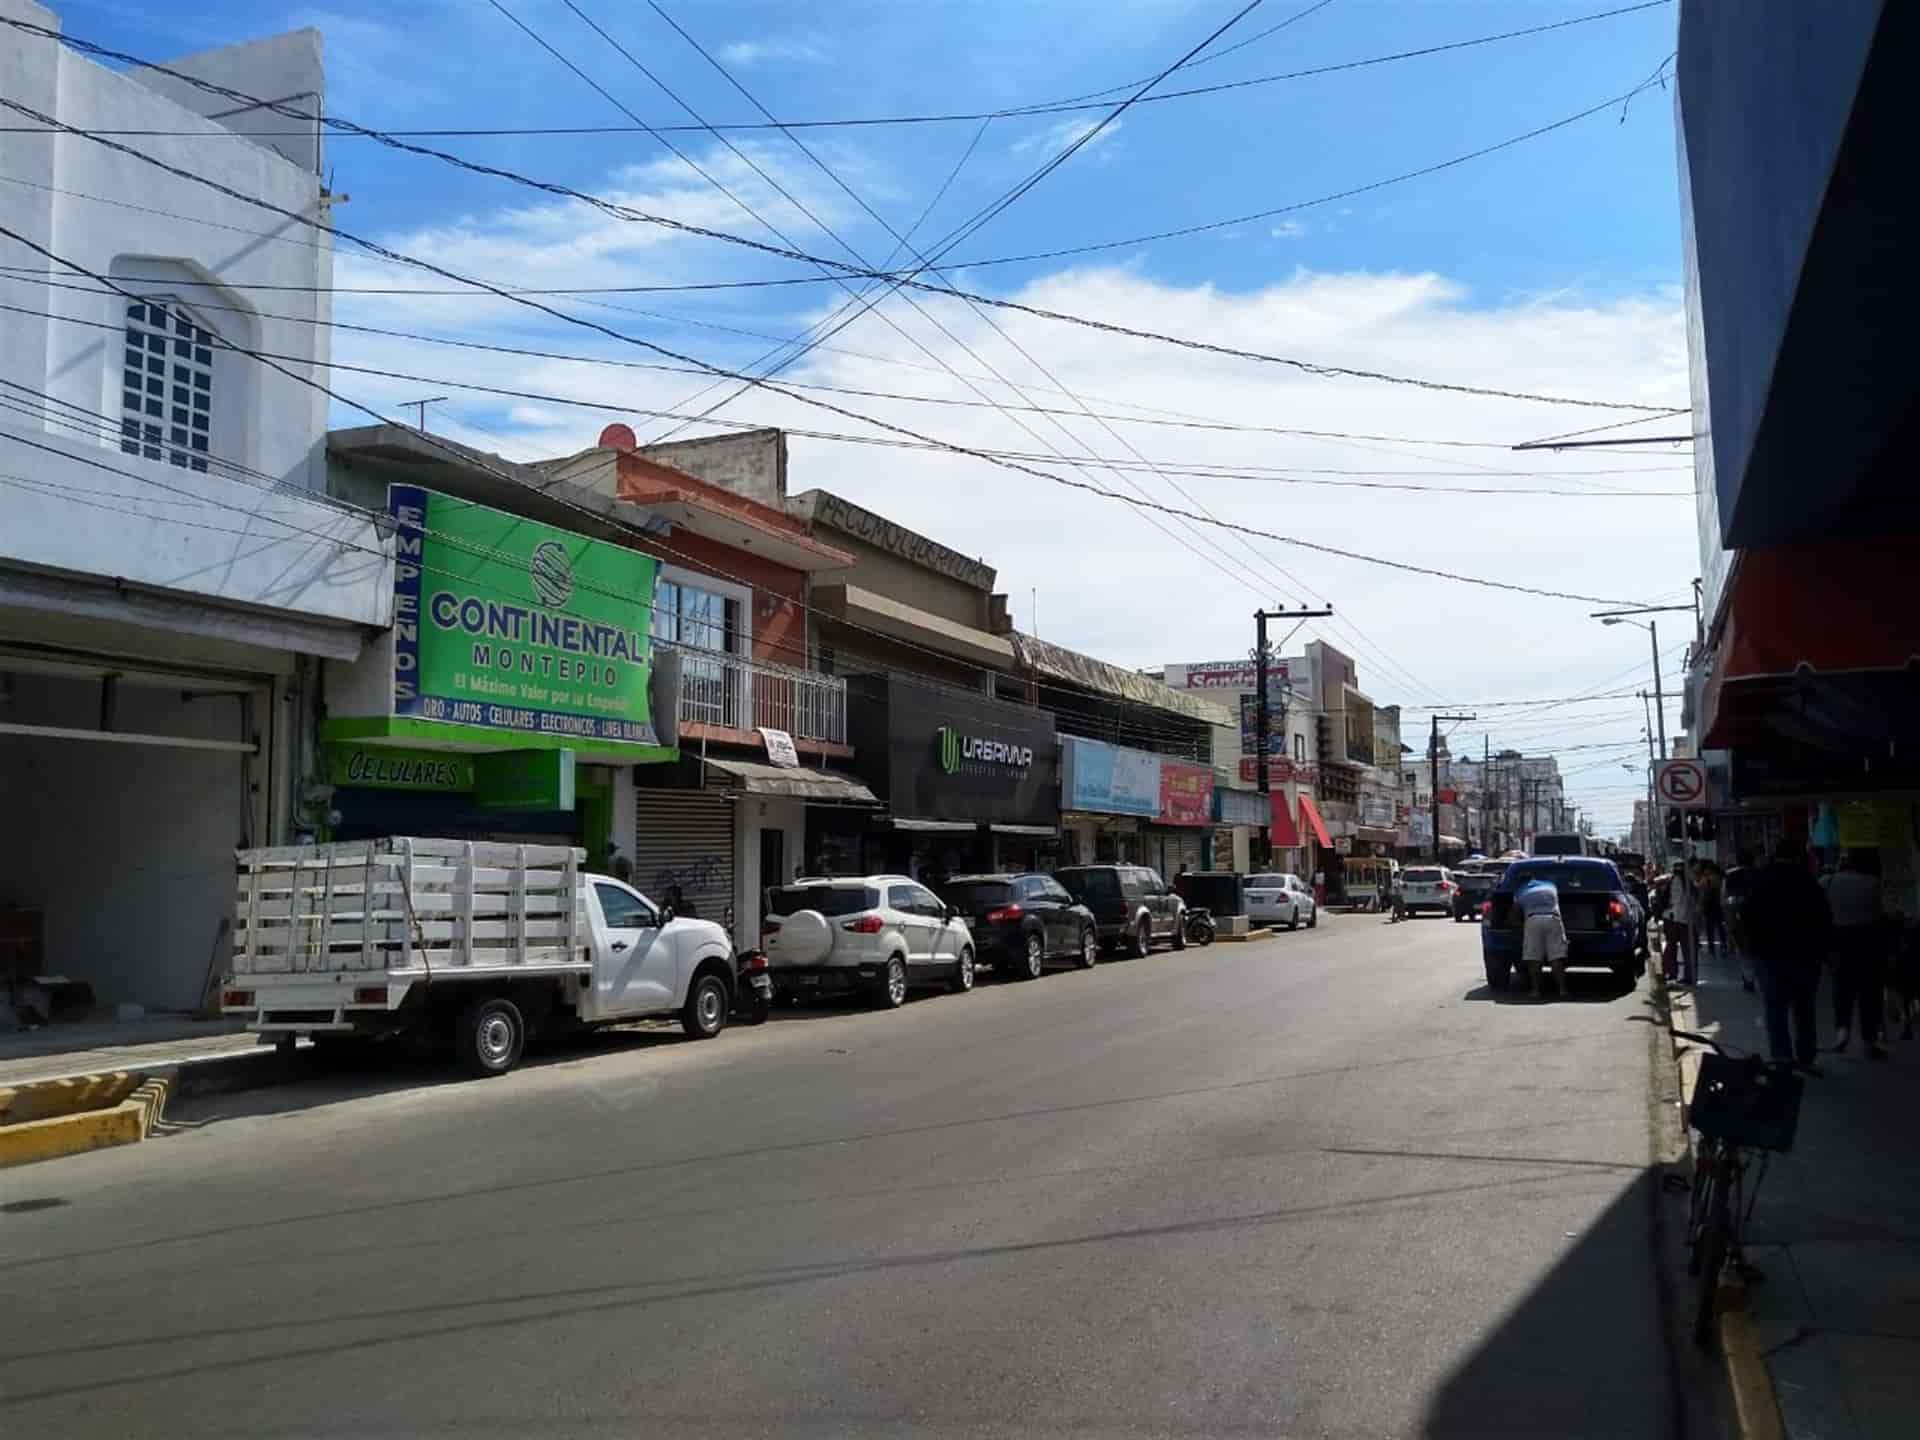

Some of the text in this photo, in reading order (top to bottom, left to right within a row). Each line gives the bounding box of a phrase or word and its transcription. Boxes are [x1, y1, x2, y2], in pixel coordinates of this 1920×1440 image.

[430, 591, 644, 665] CONTINENTAL
[473, 643, 617, 687] MONTEPIO
[520, 683, 548, 701] Valor
[551, 690, 569, 706] por
[423, 697, 445, 717] ORO
[453, 701, 482, 723] AUTOS
[489, 706, 534, 729] CELULARES
[348, 751, 457, 785] CELULARES
